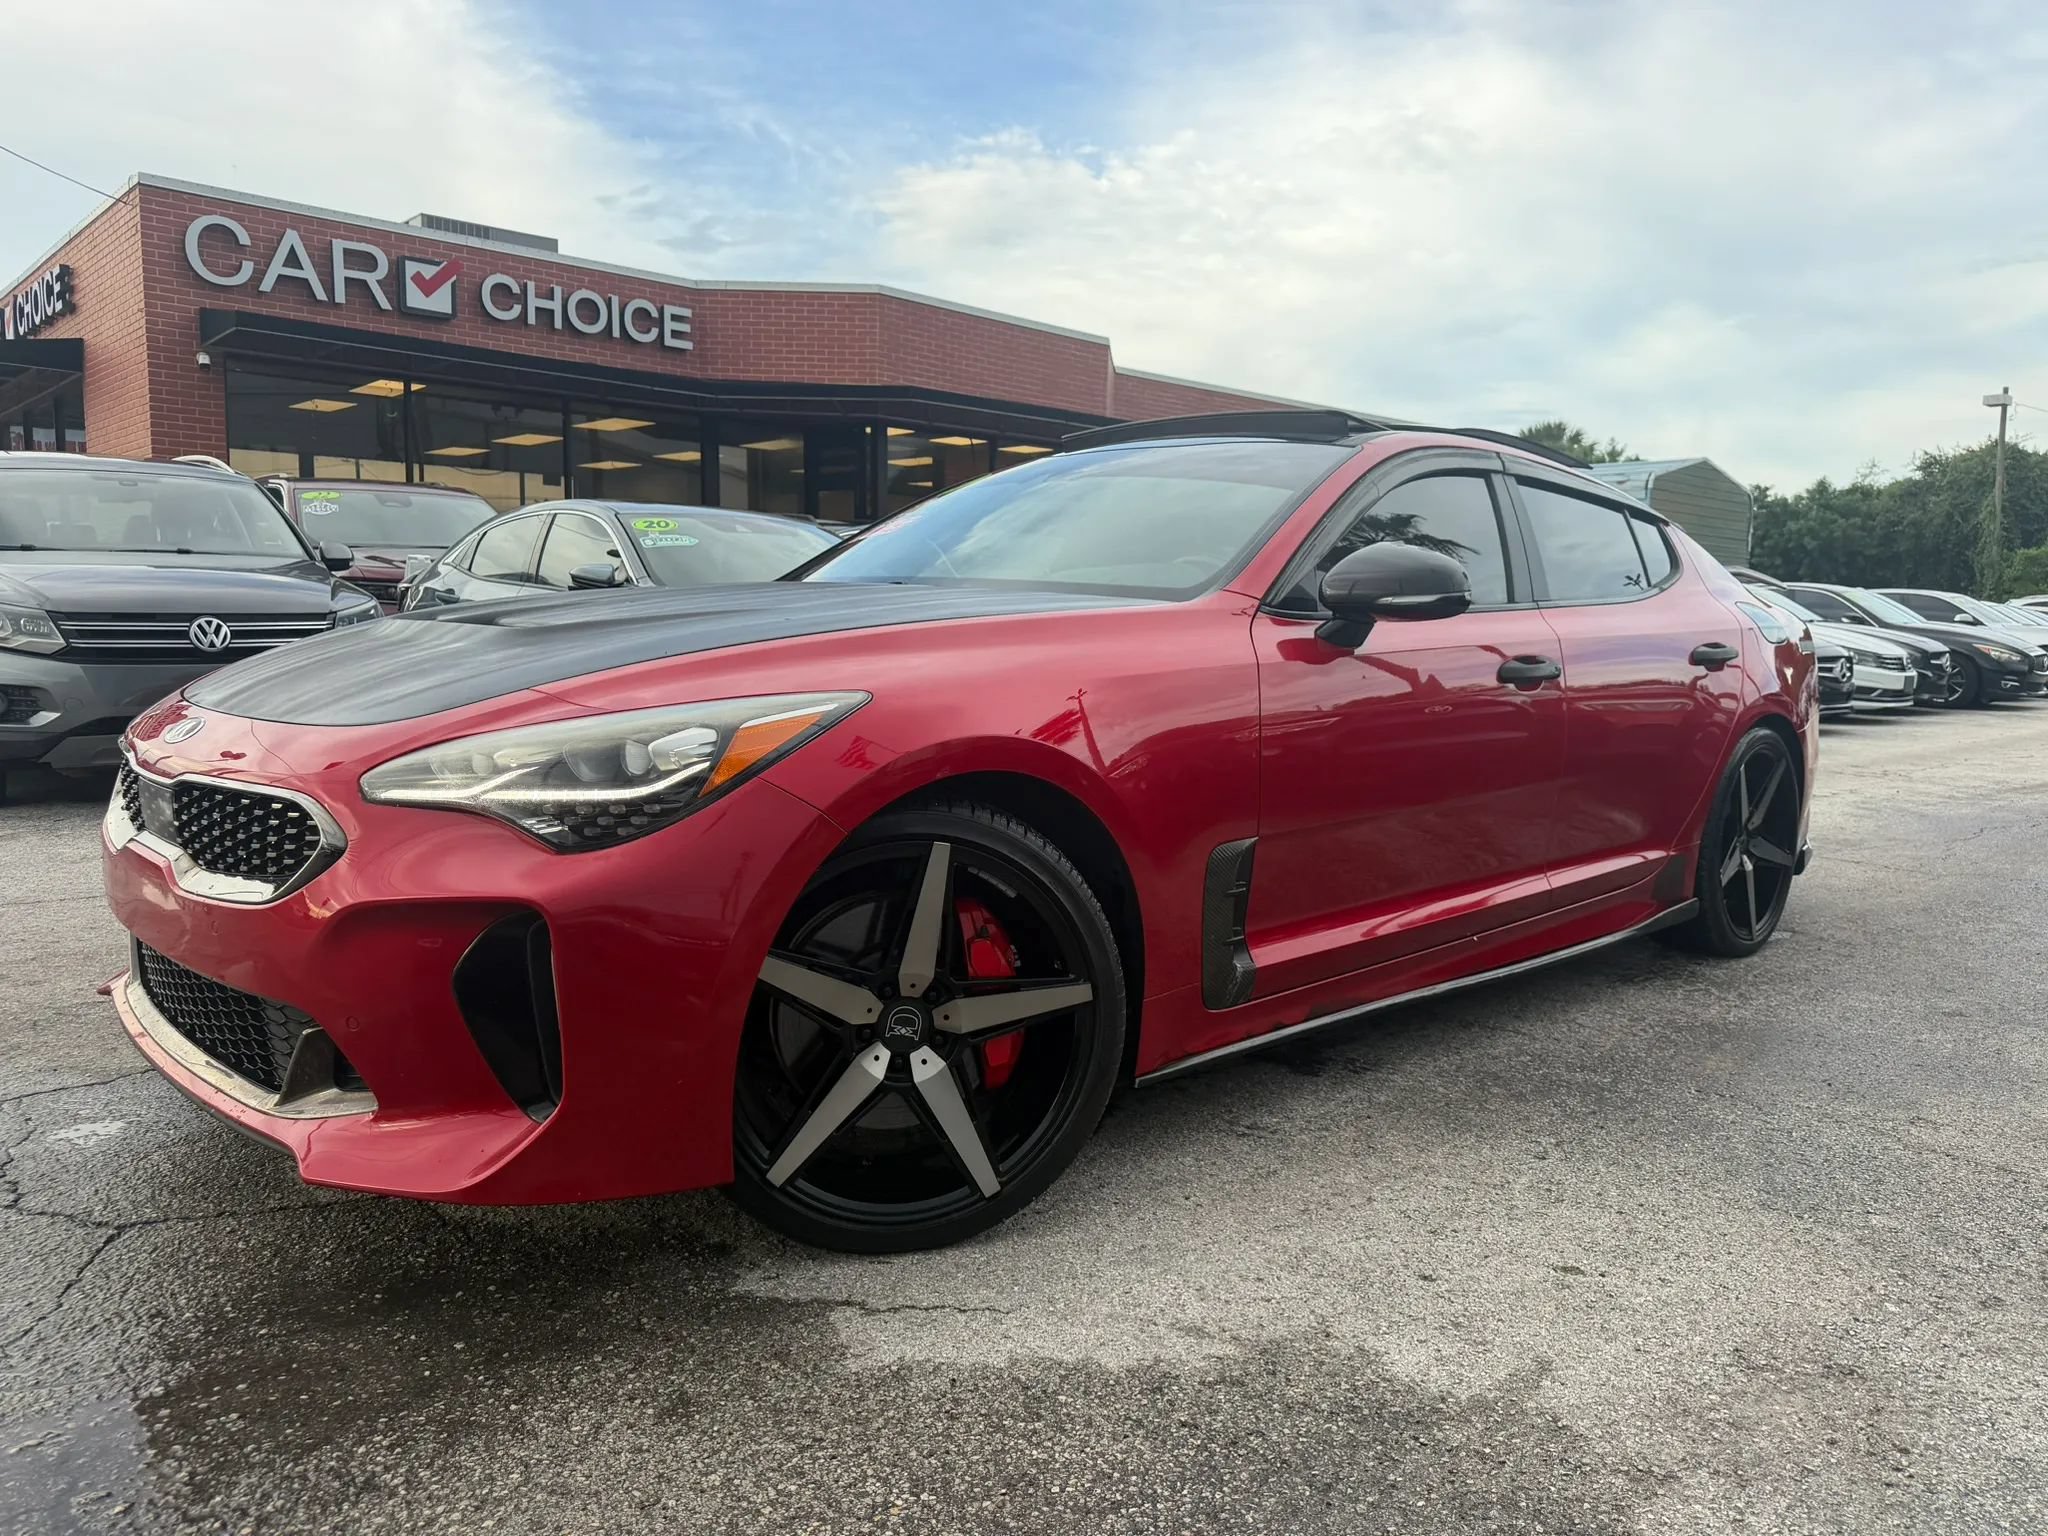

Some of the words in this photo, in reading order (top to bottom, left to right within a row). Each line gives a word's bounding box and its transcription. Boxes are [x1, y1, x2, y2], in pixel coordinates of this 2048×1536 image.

[16, 264, 63, 336] CHOICE
[184, 214, 393, 311] CAR
[481, 272, 694, 351] CHOICE
[642, 520, 671, 529] 20
